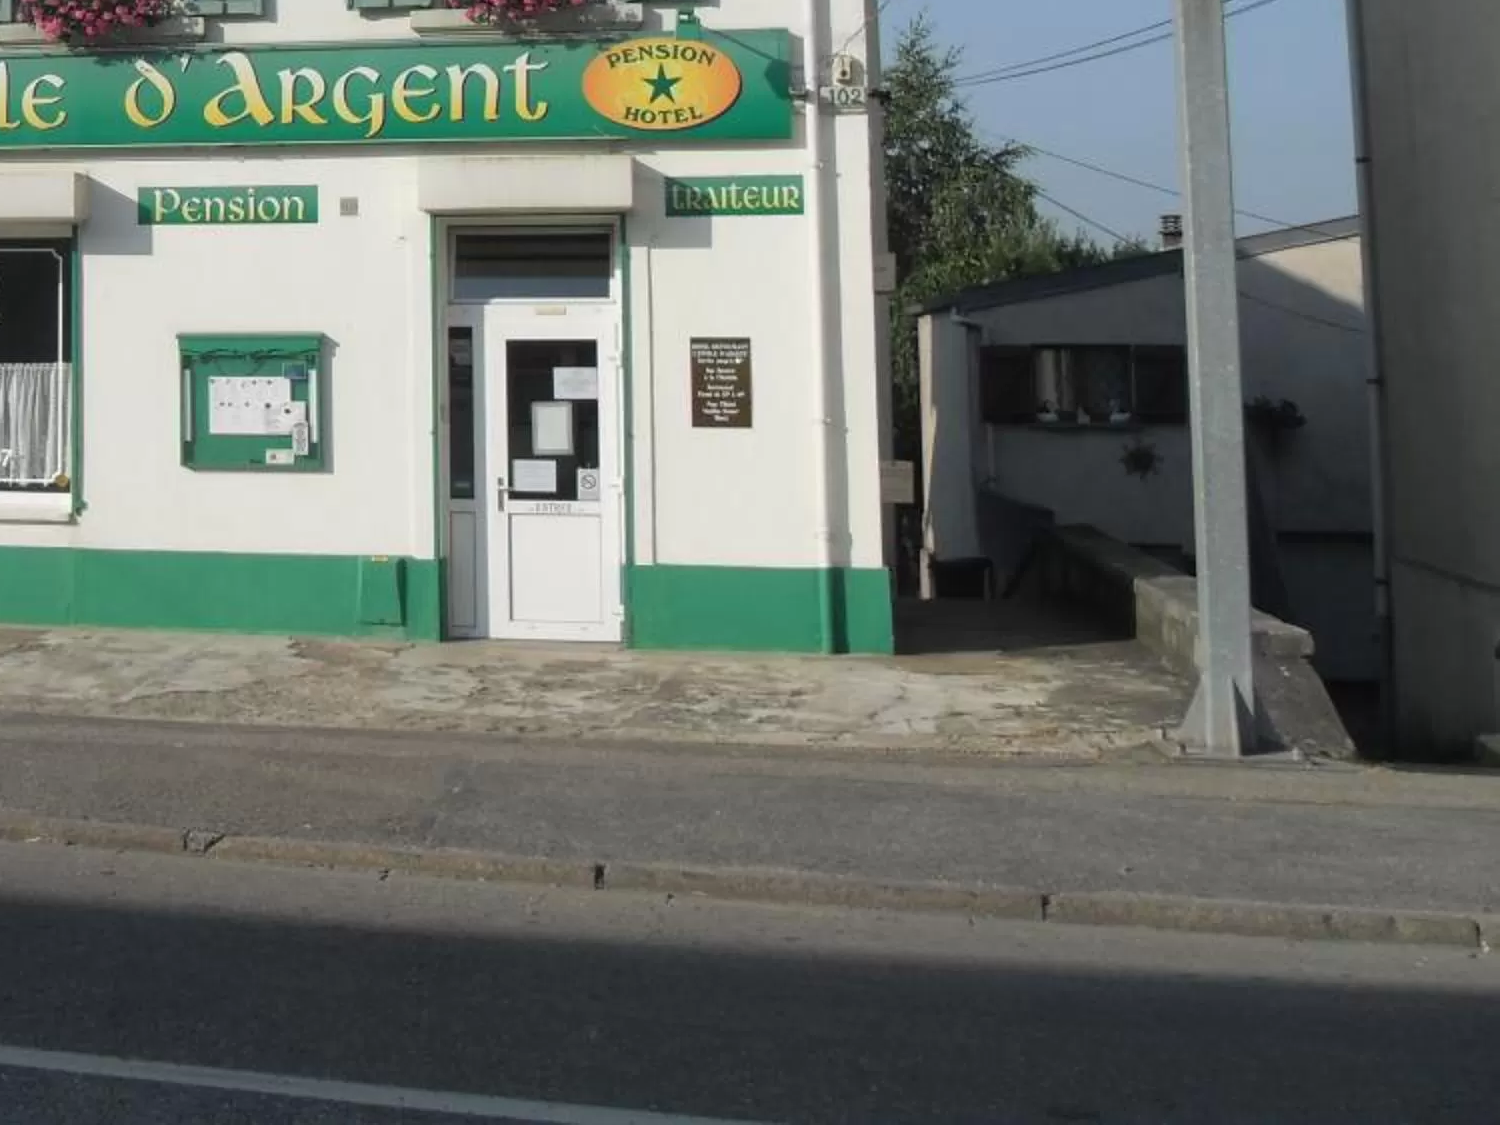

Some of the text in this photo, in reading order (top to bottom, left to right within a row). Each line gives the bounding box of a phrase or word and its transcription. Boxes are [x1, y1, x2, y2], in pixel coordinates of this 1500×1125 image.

[606, 43, 717, 69] PENSION
[123, 50, 551, 139] d'Argent
[829, 87, 864, 105] 102
[624, 105, 703, 125] HOTEL
[153, 186, 306, 222] Pension
